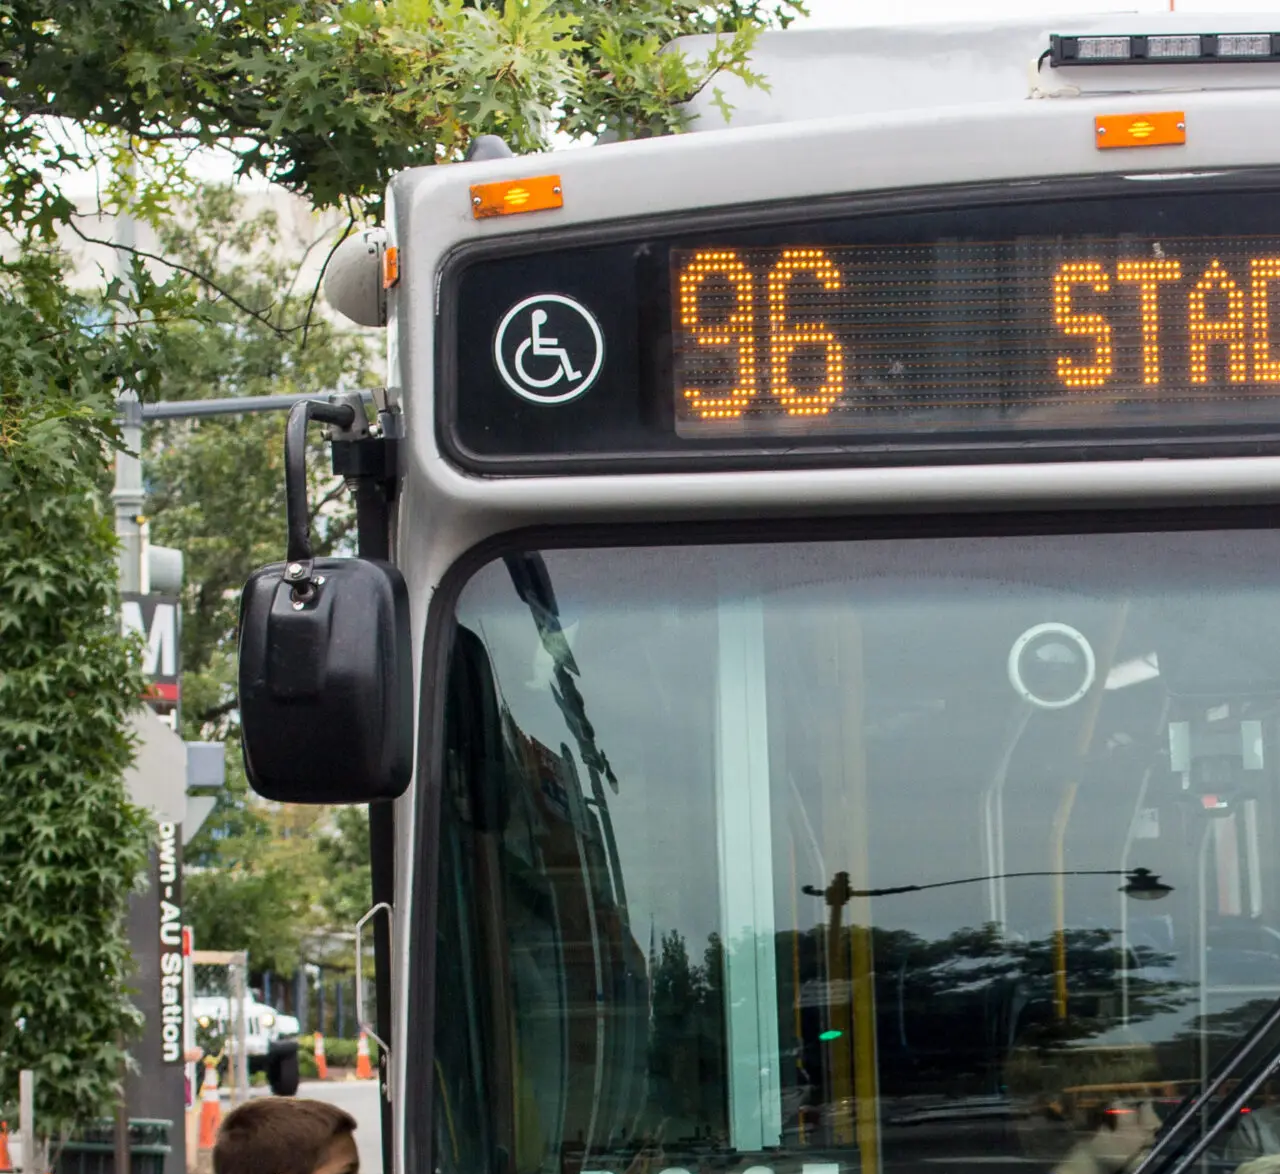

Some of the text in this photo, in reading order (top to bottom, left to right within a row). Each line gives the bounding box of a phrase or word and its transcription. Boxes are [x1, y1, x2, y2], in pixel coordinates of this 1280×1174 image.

[679, 250, 843, 417] 96
[121, 601, 176, 676] M
[161, 952, 182, 1062] Station
